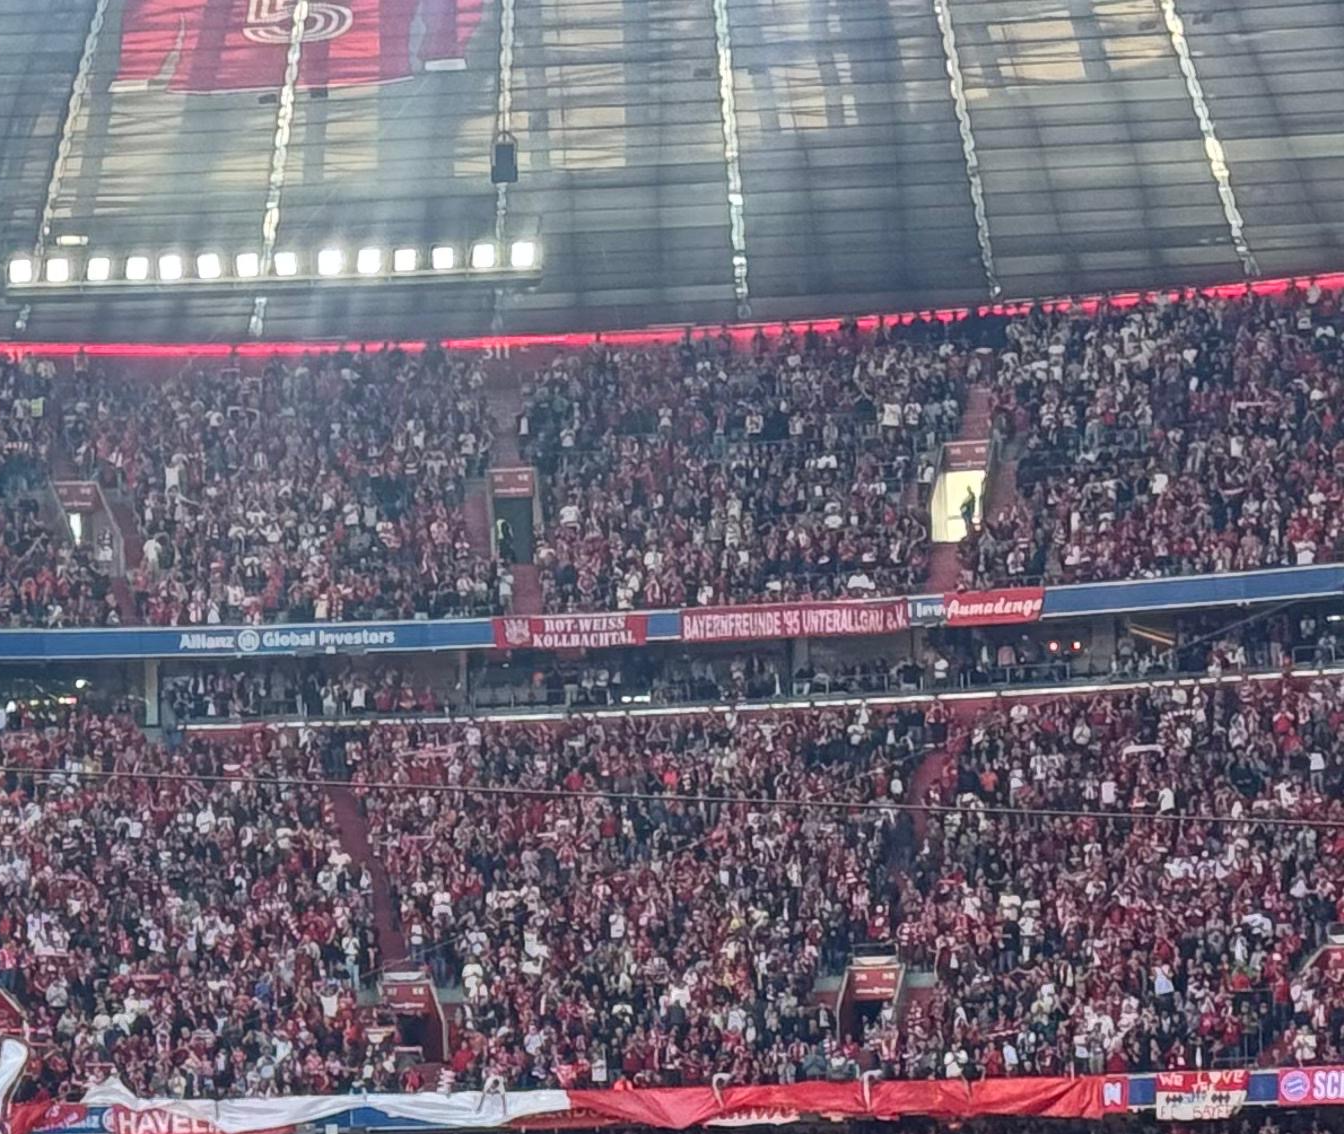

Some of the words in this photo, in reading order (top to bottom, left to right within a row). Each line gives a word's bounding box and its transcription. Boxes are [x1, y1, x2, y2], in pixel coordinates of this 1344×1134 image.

[179, 633, 235, 650] Allianz
[263, 630, 316, 647] Global
[319, 629, 395, 646] Investors
